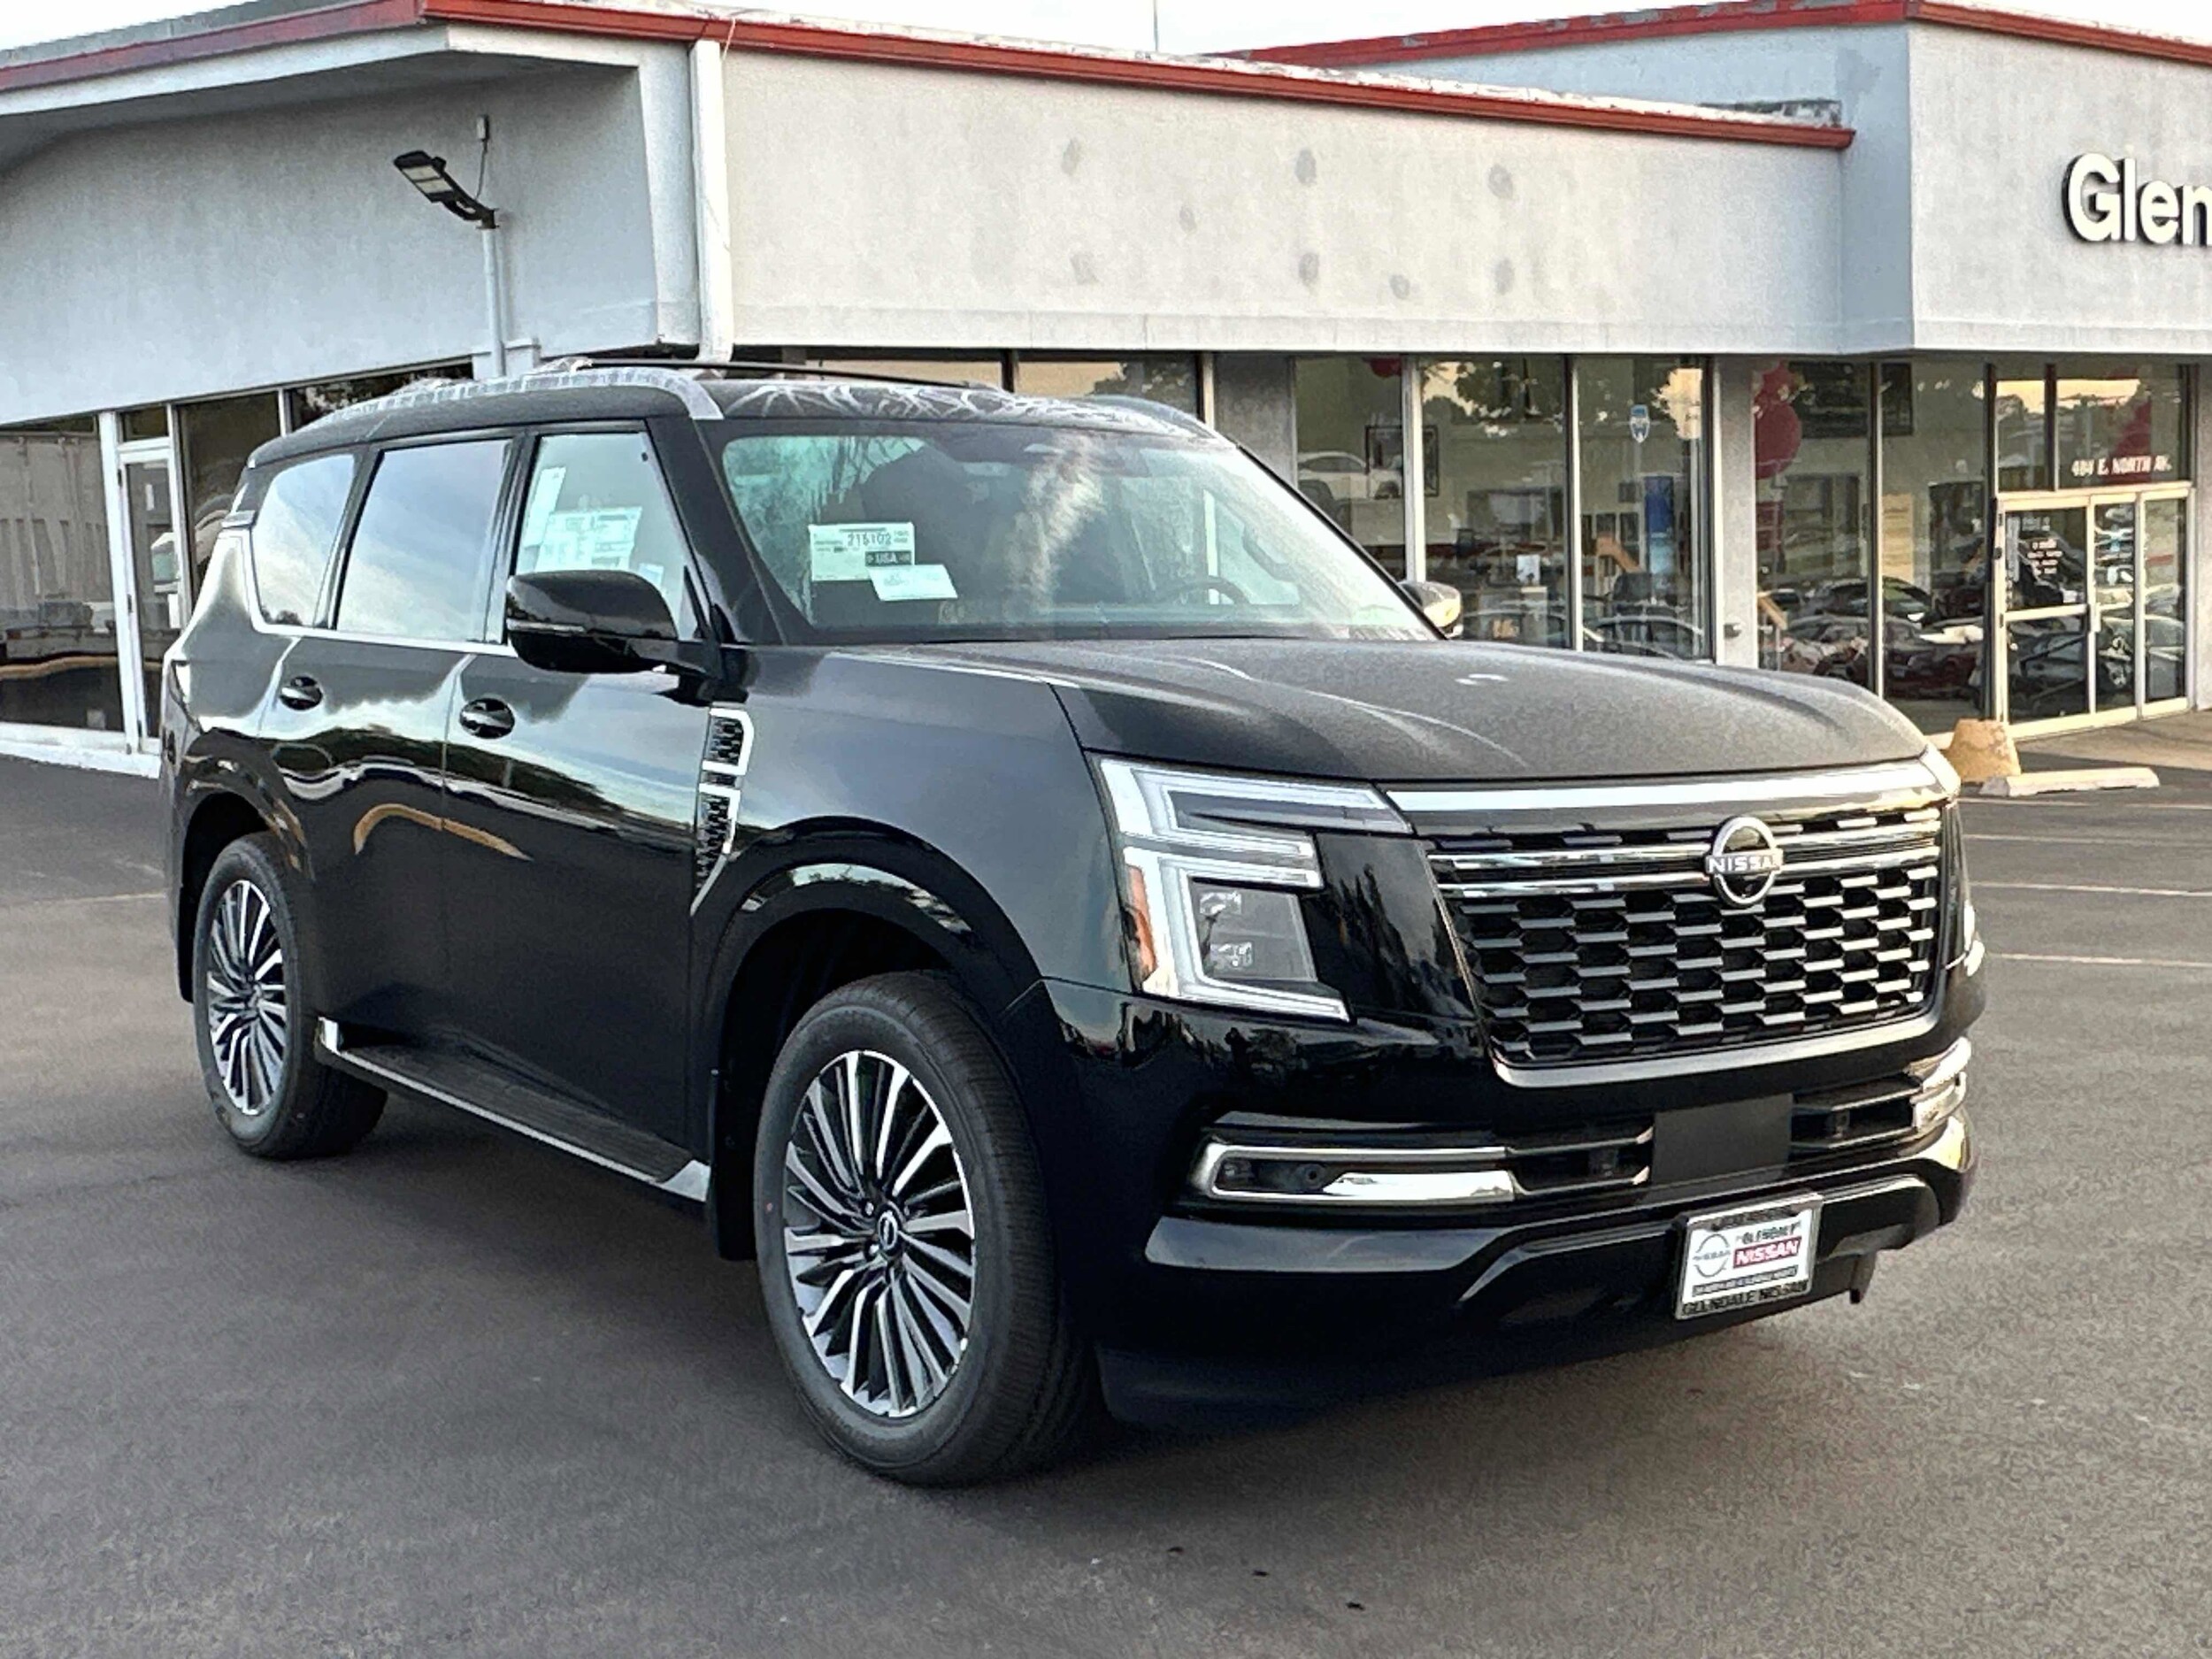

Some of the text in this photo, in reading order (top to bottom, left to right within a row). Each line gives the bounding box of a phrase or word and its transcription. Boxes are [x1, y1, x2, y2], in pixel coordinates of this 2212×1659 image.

[2062, 153, 2212, 247] Glen
[2111, 455, 2151, 475] NORTH
[1736, 1239, 1800, 1266] NISSAN
